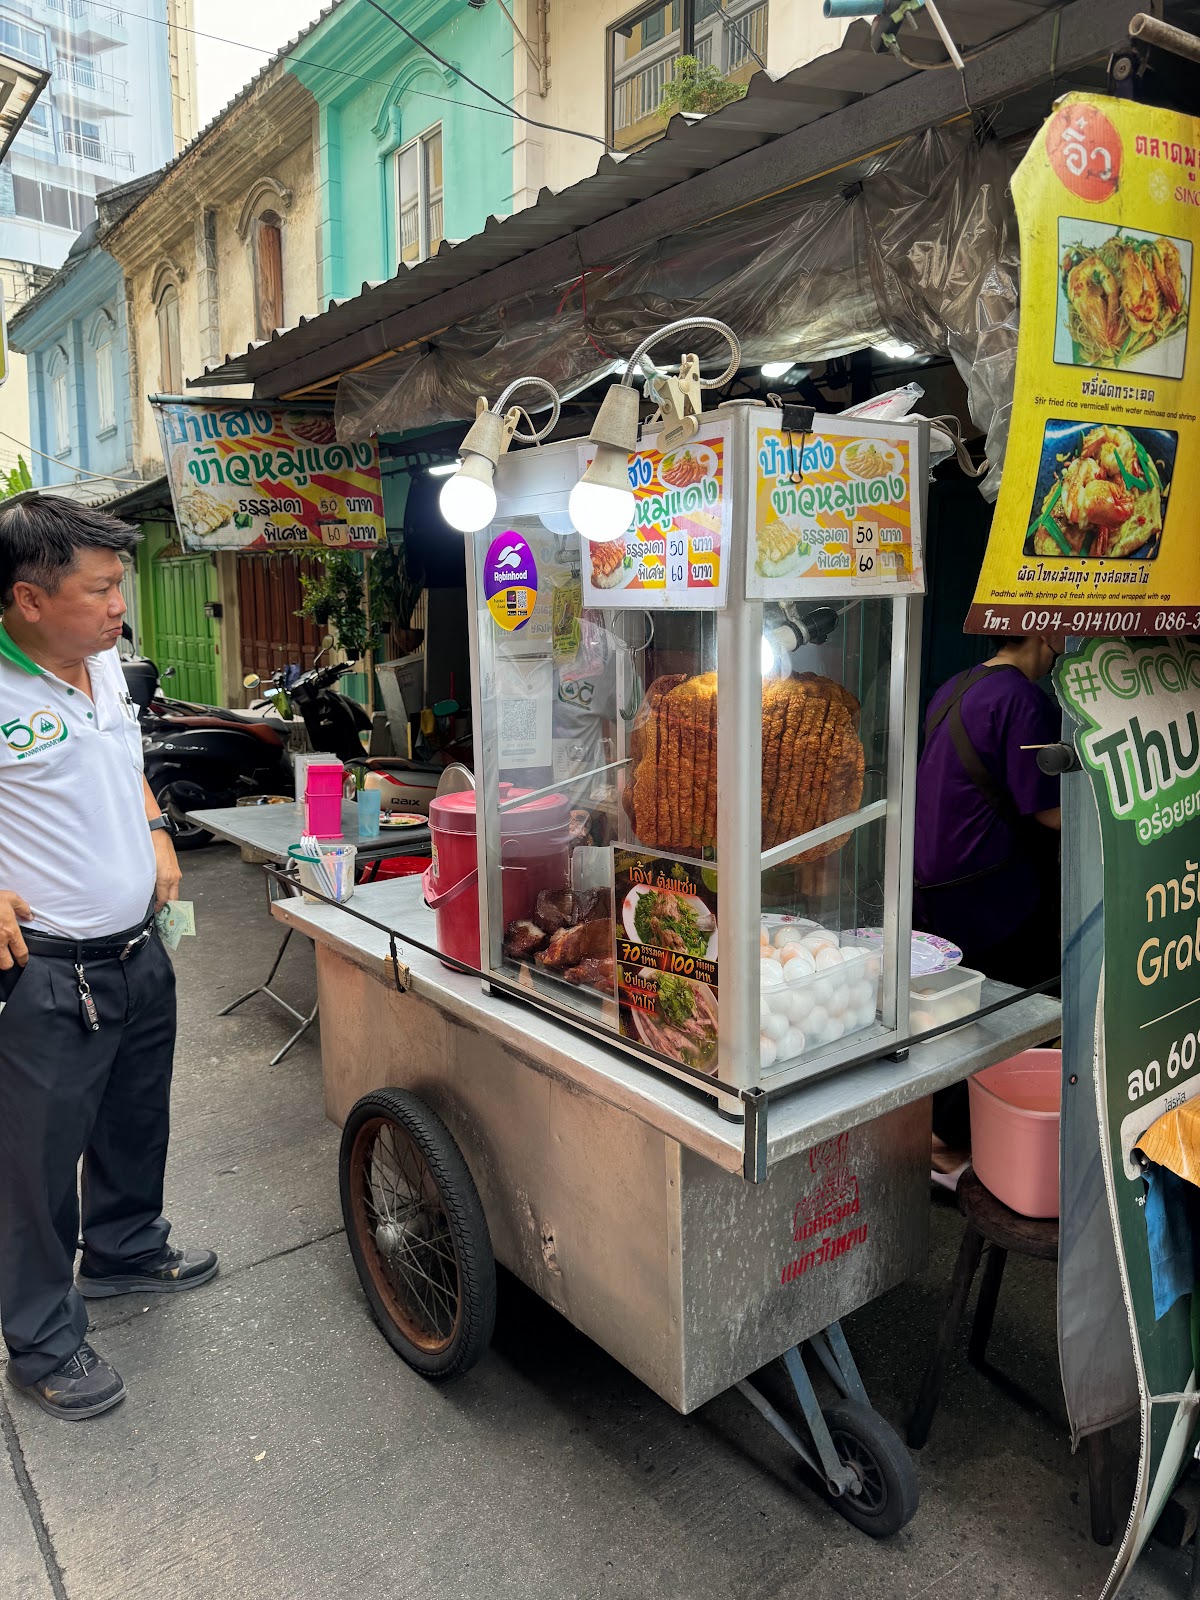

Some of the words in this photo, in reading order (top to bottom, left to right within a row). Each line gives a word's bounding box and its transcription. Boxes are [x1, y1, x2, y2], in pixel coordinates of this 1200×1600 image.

[1082, 372, 1155, 402] หมี่ผัดกระเฉด
[1035, 396, 1046, 405] Stir
[1049, 397, 1064, 407] fried
[1066, 400, 1078, 408] rice
[1080, 401, 1109, 412] vermicelli
[1111, 405, 1123, 413] with
[1126, 407, 1142, 415] water
[1144, 408, 1165, 418] mimosa
[1167, 411, 1177, 419] and
[1179, 411, 1196, 421] shrimp
[163, 405, 273, 445] ป้าแสง
[188, 442, 373, 486] ข้าวหมูแดง
[760, 439, 834, 475] ป้าแสง
[239, 499, 302, 516] ธรรมดา
[320, 500, 338, 514] 50
[346, 499, 373, 513] บาท
[773, 475, 904, 518] ข้าวหมูแดง
[264, 522, 308, 542] พิเศษ
[328, 526, 341, 541] 60
[350, 526, 377, 540] บาท
[803, 529, 848, 543] ธรรมดา
[856, 526, 873, 543] 50
[880, 529, 902, 542] บาท
[626, 542, 664, 558] ธรรมดา
[669, 541, 684, 556] 50
[693, 537, 712, 551] บาท
[638, 563, 665, 580] พิเศษ
[672, 565, 683, 581] 60
[692, 564, 712, 578] บาท
[818, 552, 850, 568] พิเศษ
[859, 555, 873, 572] 60
[494, 570, 528, 583] Robinhood
[1017, 560, 1090, 590] ผัดไทยมันกุ้ง
[1094, 560, 1151, 590] กุ้งสดห่อไข่
[990, 590, 1017, 598] Padthai
[1019, 590, 1034, 598] with
[1036, 591, 1058, 600] shrimp
[1087, 592, 1106, 600] shrimp
[1108, 592, 1119, 600] and
[1121, 593, 1146, 601] wrapped
[1148, 592, 1159, 600] with
[24, 738, 61, 758] ANNIVERSARY
[391, 797, 420, 806] QBIX
[622, 944, 640, 961] 70
[670, 953, 694, 975] 100
[641, 955, 657, 968] บาท
[695, 970, 712, 983] บาท
[1127, 1060, 1161, 1101] ลด
[1167, 1029, 1200, 1079] 60
